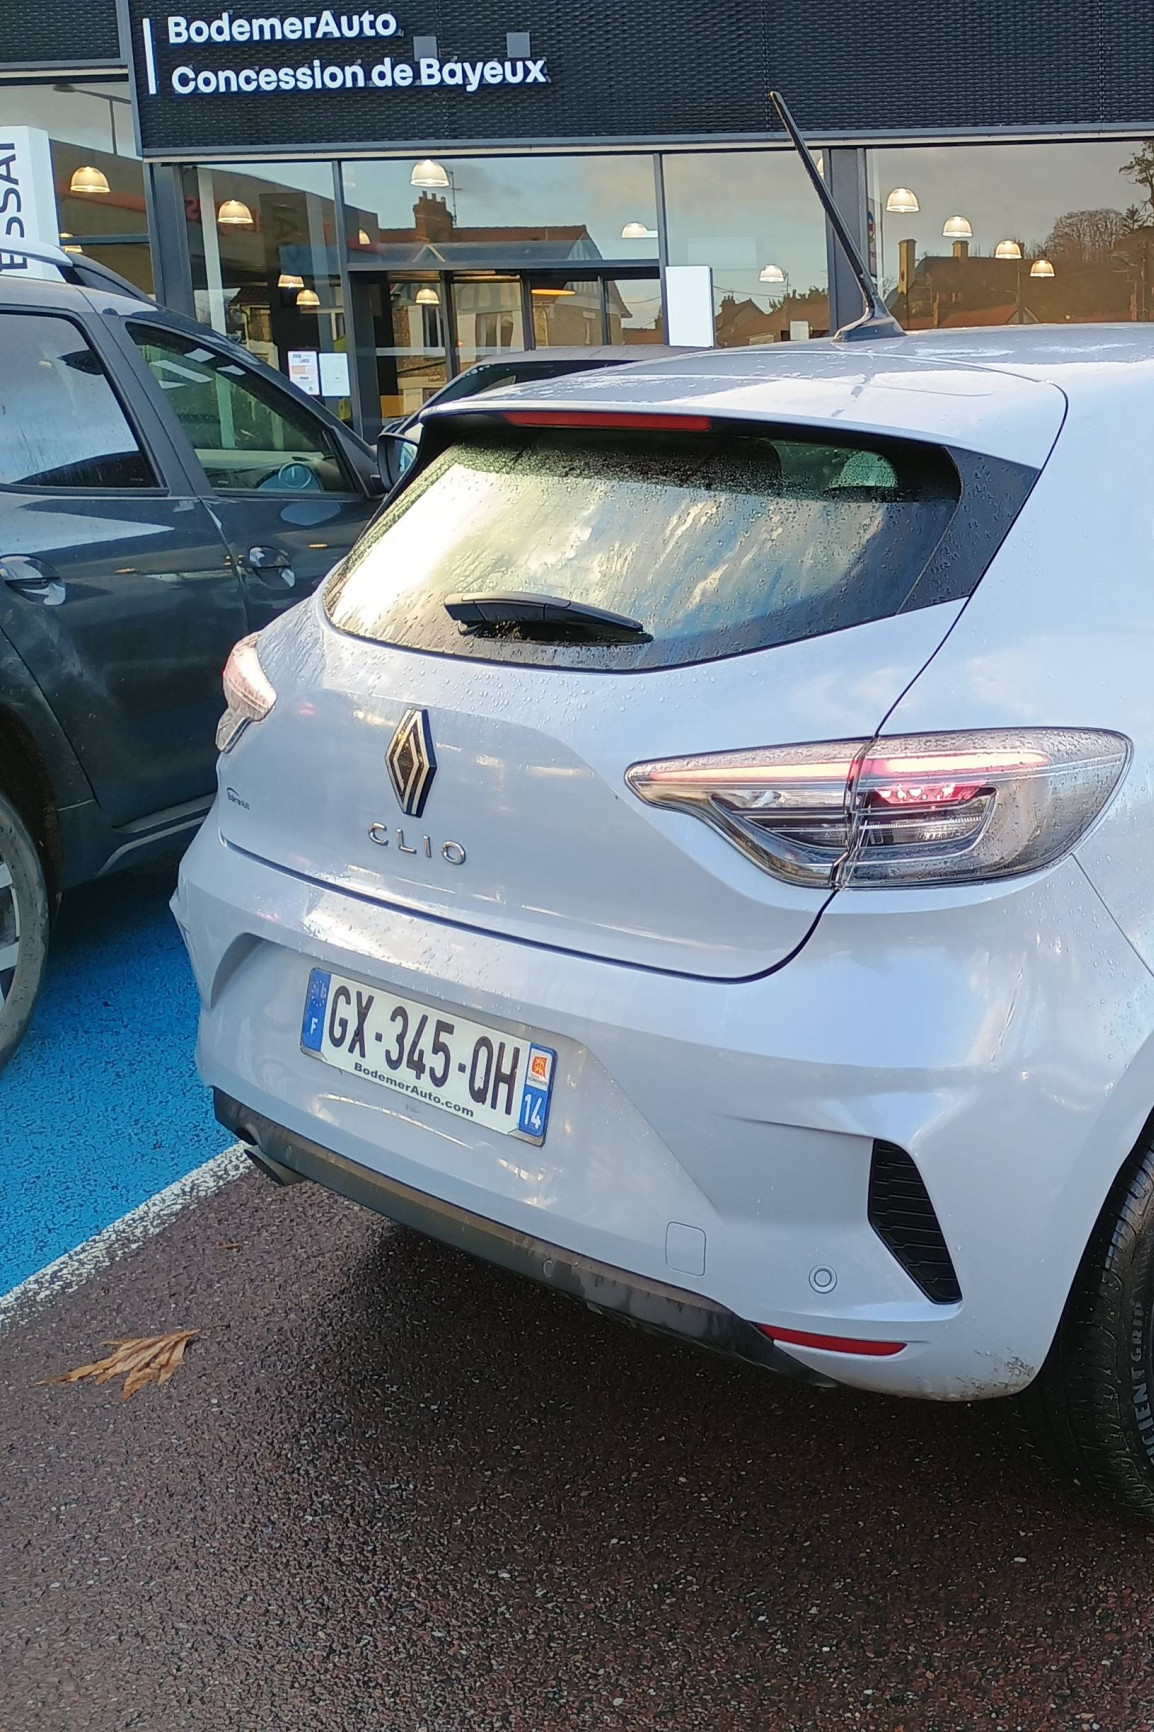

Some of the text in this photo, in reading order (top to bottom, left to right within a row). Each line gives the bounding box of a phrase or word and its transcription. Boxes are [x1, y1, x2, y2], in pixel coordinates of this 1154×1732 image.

[167, 10, 398, 44] BodemerAuto
[171, 57, 547, 94] Concession de Bayeux
[368, 822, 466, 865] CLIO
[310, 1018, 319, 1034] F
[328, 985, 521, 1116] GX-345-QH
[354, 1062, 474, 1118] BodemerAuto.com
[524, 1093, 543, 1129] 14
